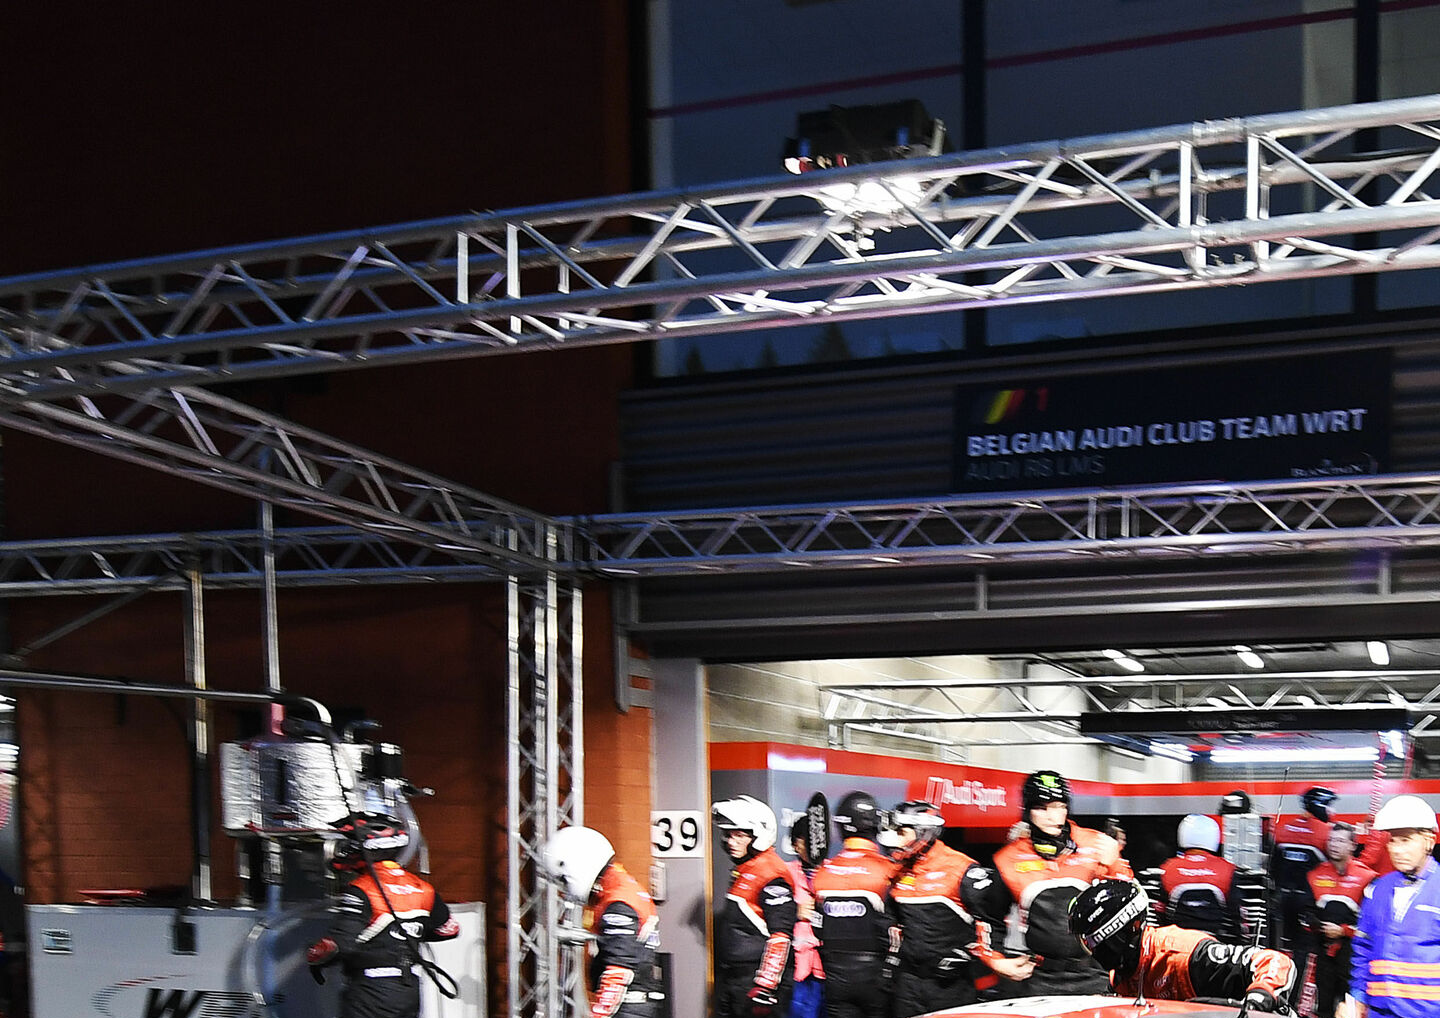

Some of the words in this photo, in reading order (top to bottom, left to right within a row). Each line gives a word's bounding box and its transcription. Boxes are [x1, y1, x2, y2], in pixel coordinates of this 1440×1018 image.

[966, 429, 1077, 457] BELGIAN
[1078, 425, 1144, 450] AUDI
[1147, 419, 1217, 446] CLUB
[1218, 412, 1299, 441] TEAM
[1301, 408, 1369, 435] WRT
[655, 816, 698, 851] 39
